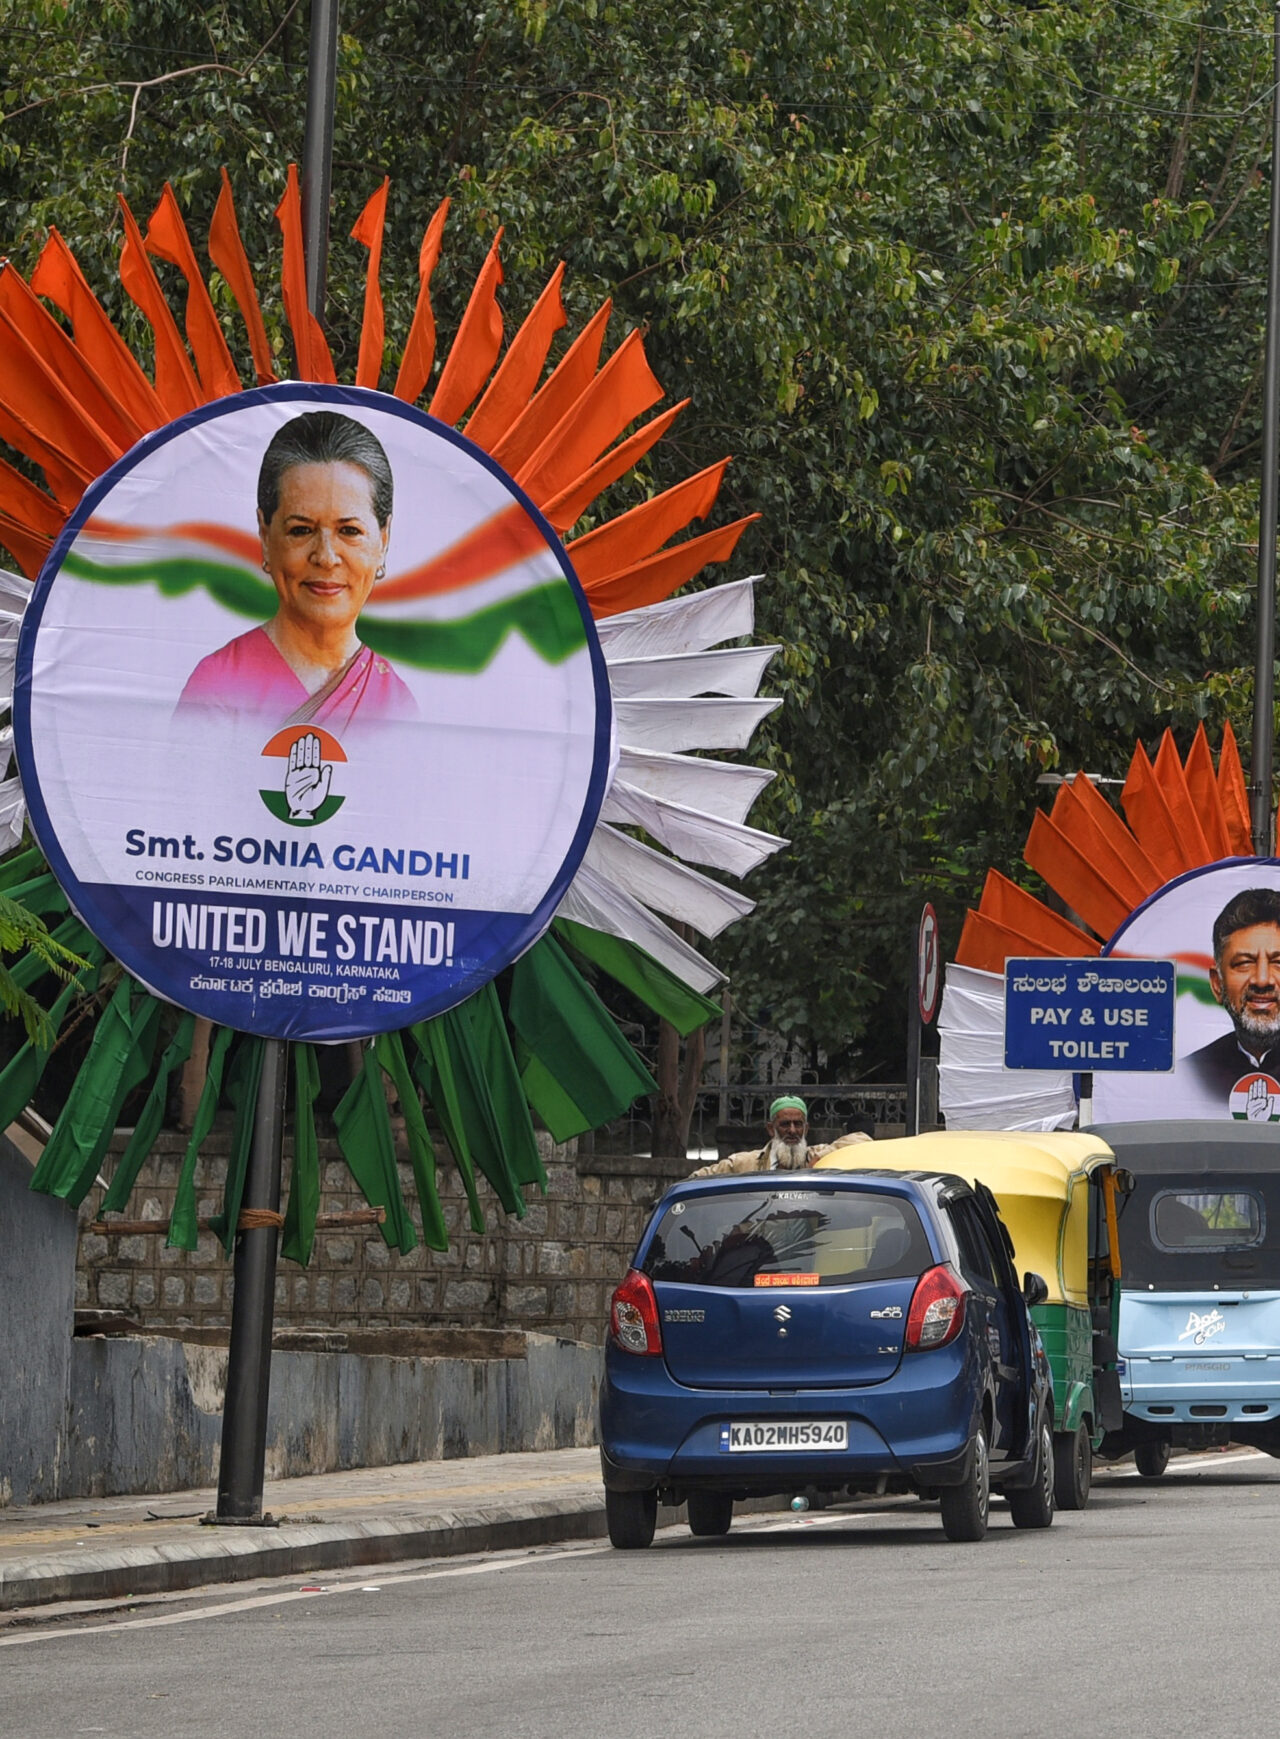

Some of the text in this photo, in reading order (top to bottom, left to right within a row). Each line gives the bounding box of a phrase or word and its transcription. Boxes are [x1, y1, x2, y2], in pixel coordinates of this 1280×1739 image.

[125, 829, 471, 880] Smt. SONIA GANDHI
[135, 870, 454, 903] CONGRESS PARLIAMENTARY PARTY CHAIRPERSON
[152, 901, 455, 967] UNITED WE STAND!
[209, 956, 400, 980] 17-18 JULY BENGALURU, KARNATAKA
[189, 975, 412, 1004] ಕರ್ನಾಟಕ ಪ್ರದೇಶ ಕಾಂಗ್ರೆಸ್ ಸಮಿತಿ
[1013, 972, 1167, 994] ಸುಲಭ ಶೌಚಾಲಯ
[1030, 1007, 1148, 1027] PAY & USE
[1049, 1041, 1130, 1059] TOILET
[731, 1425, 844, 1446] KA02MH5940
